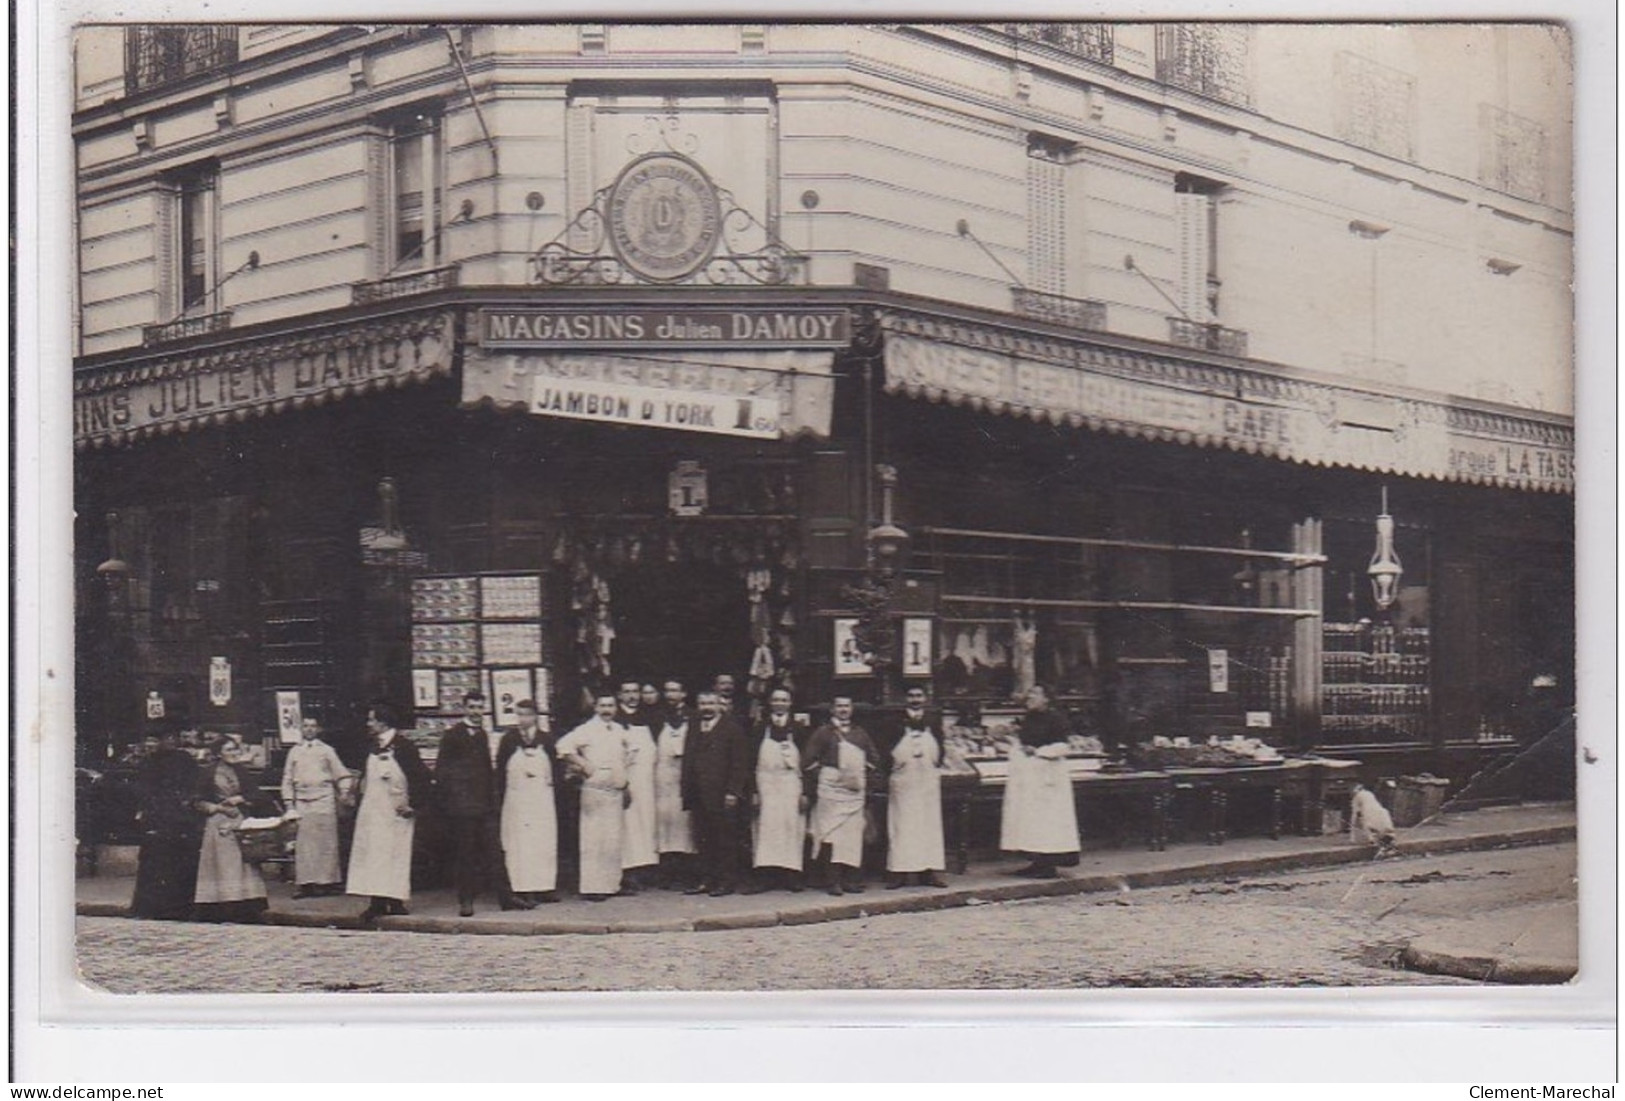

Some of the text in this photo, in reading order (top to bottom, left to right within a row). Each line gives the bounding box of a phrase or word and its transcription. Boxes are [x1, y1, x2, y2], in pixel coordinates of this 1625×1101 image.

[489, 314, 837, 340] MAGASINS Julien DAMOY
[149, 361, 276, 418] JULIEN
[295, 335, 432, 389] DAMOY
[536, 387, 629, 418] JAMBON
[665, 400, 716, 427] YORK
[502, 692, 513, 714] 2
